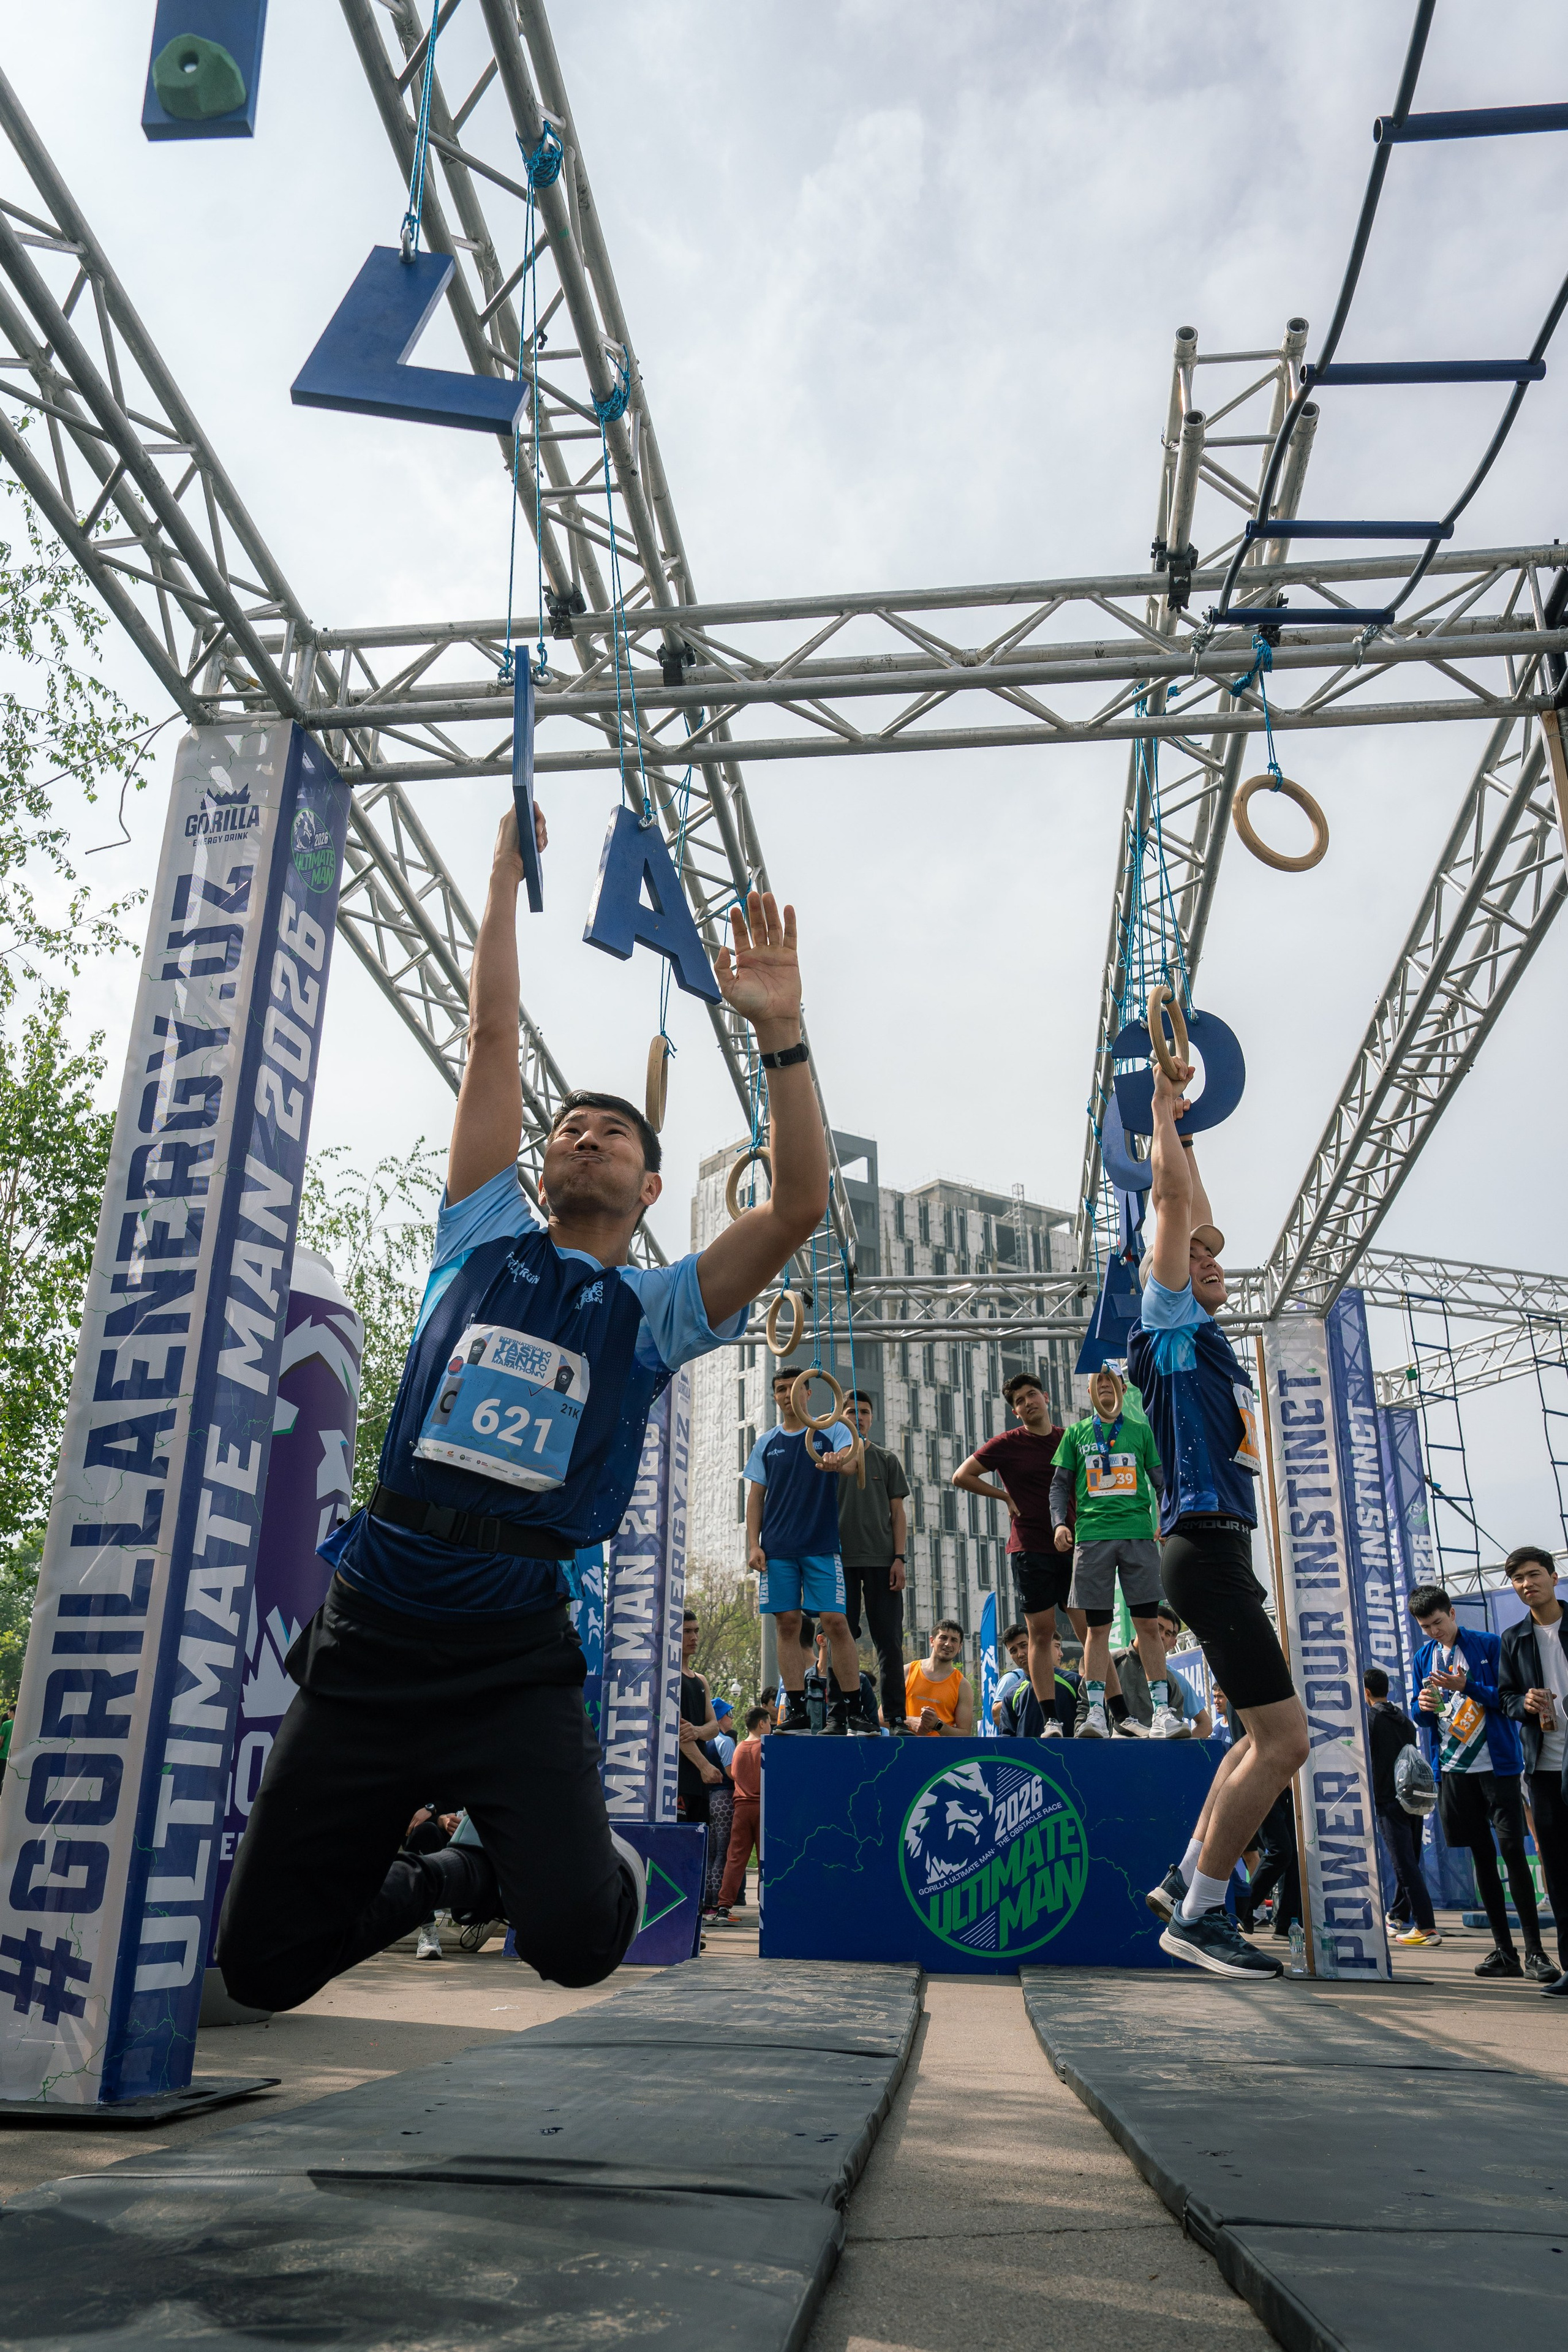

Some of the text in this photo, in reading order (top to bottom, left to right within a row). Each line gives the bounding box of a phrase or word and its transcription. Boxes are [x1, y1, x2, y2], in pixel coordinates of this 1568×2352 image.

[185, 805, 260, 837] GORILLA
[193, 831, 249, 847] ENERGY DRINK
[314, 831, 329, 847] 2026
[295, 849, 335, 870] ULTIMATE
[311, 864, 333, 887] MAN
[255, 892, 327, 1142] 2026
[217, 1154, 295, 1396] MAN
[491, 1359, 538, 1377] MARATHON
[500, 1336, 543, 1352] INTERNATIONAL
[440, 1390, 458, 1414] C
[472, 1398, 552, 1454] 621
[560, 1403, 581, 1419] 21K
[1346, 1398, 1401, 1692] YOUR INSTINCT
[612, 1555, 655, 1659] MAN
[1281, 1369, 1377, 1970] POWER YOUR INSTINCT
[134, 1423, 263, 1992] ULTIMATE
[604, 1681, 650, 1822] MATE
[994, 1774, 1042, 1842] 2026
[918, 1880, 949, 1896] GORILLA
[949, 1861, 980, 1883] ULTIMATE
[997, 1835, 1011, 1849] THE
[1009, 1812, 1042, 1838] OBSTACLE
[1042, 1802, 1063, 1815] RACE
[929, 1810, 1080, 1936] ULTIMATE
[999, 1857, 1080, 1950] MAN
